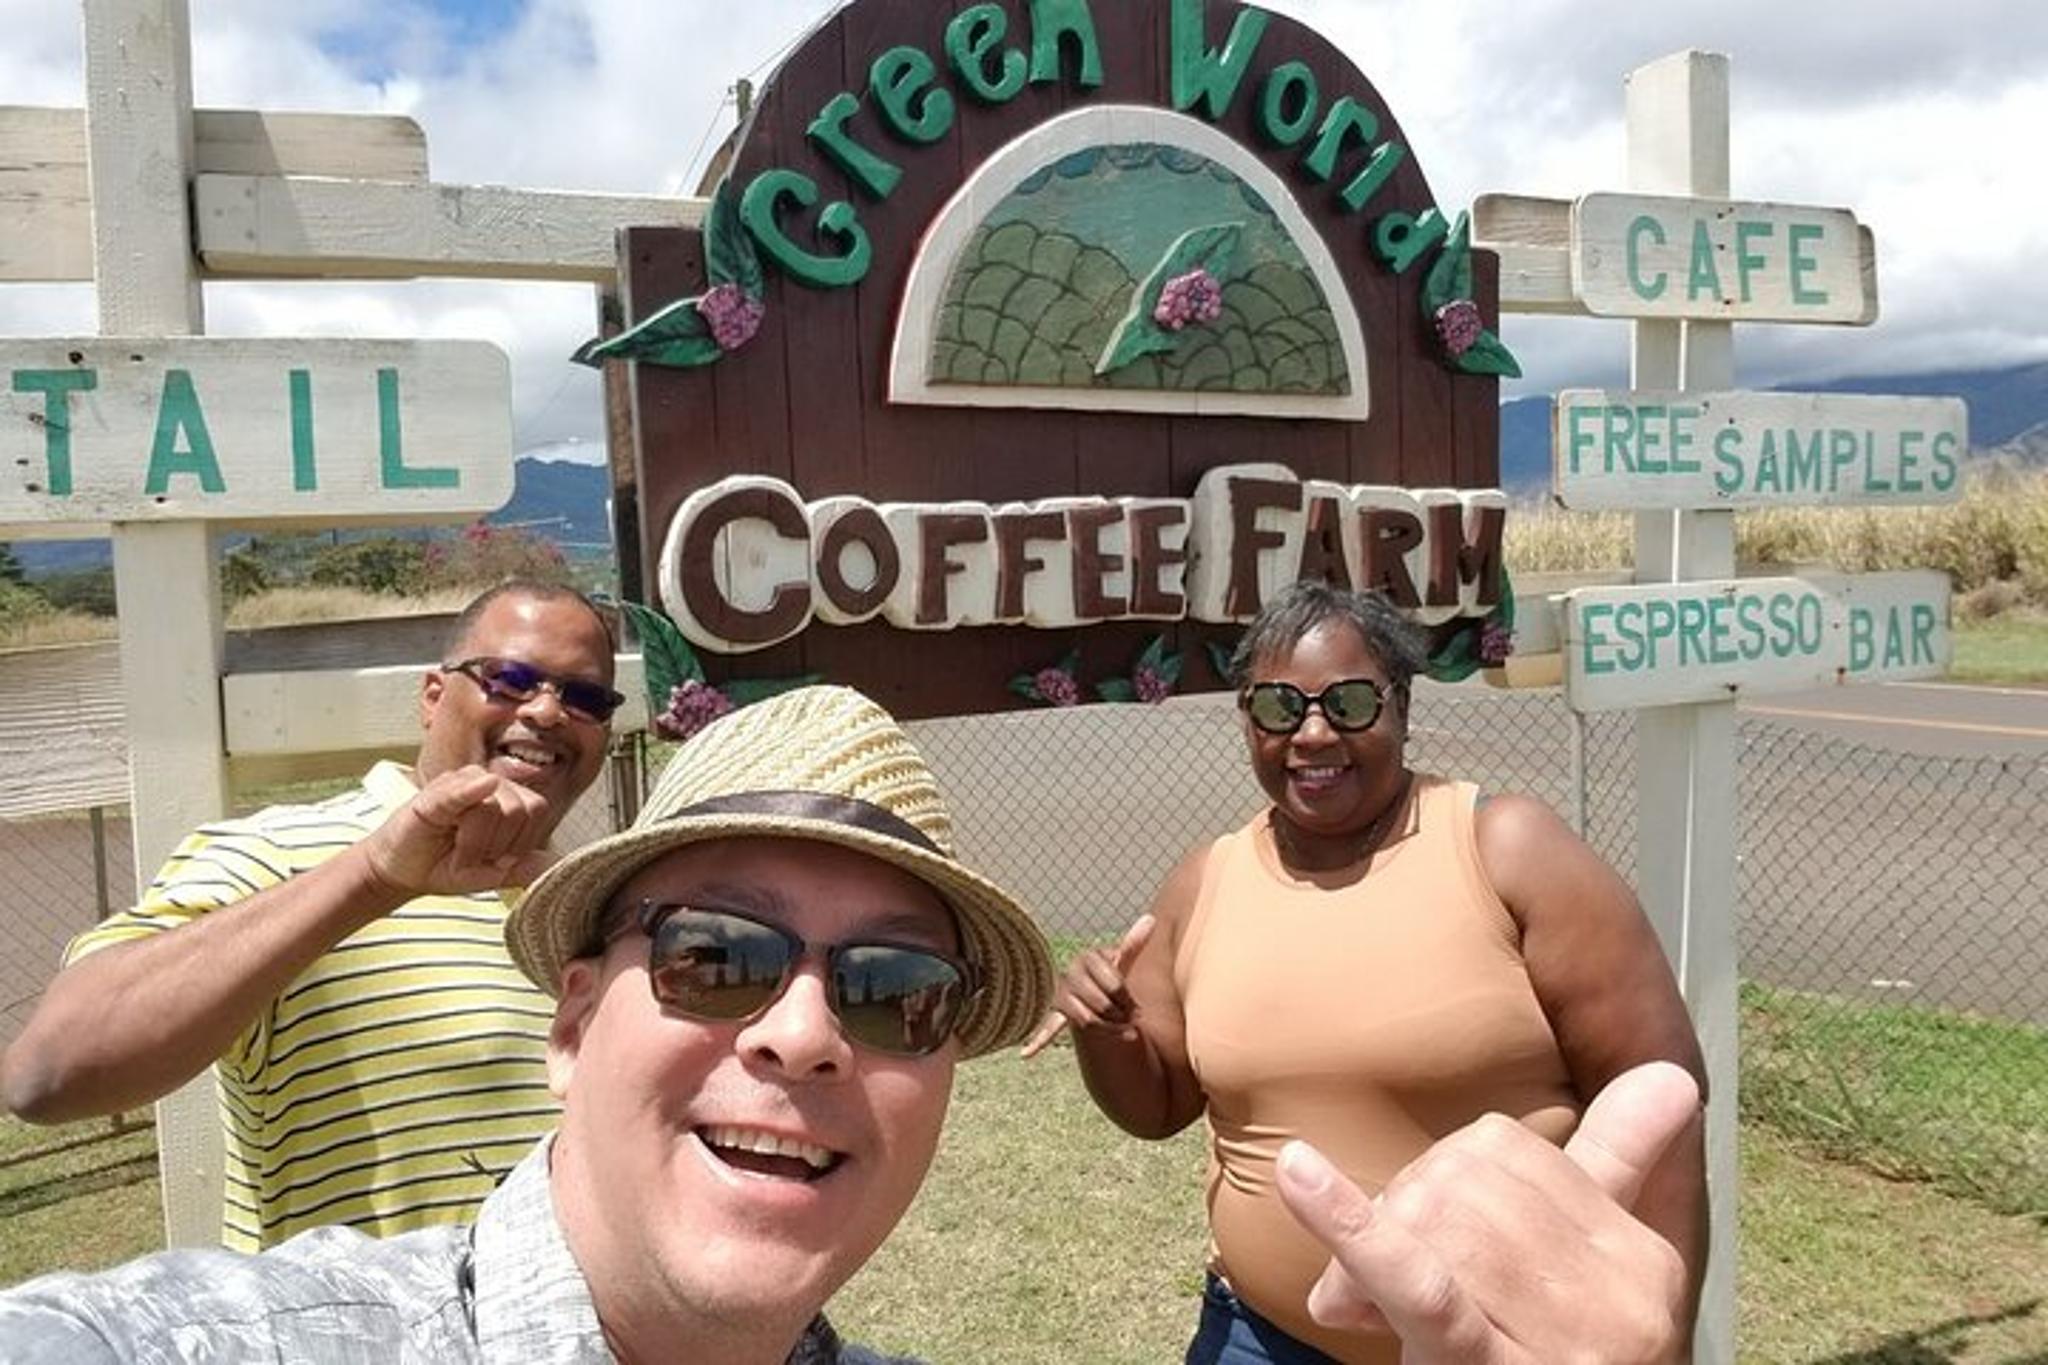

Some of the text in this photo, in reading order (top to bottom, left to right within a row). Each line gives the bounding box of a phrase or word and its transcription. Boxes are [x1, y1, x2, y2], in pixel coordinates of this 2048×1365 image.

[741, 0, 1449, 286] Green World
[1626, 215, 1829, 305] CAFE
[12, 369, 460, 494] TAIL
[1568, 405, 1958, 493] FREE SAMPLES
[680, 476, 1506, 643] COFFEE FARM
[1582, 593, 1936, 674] ESPRESSO BAR
